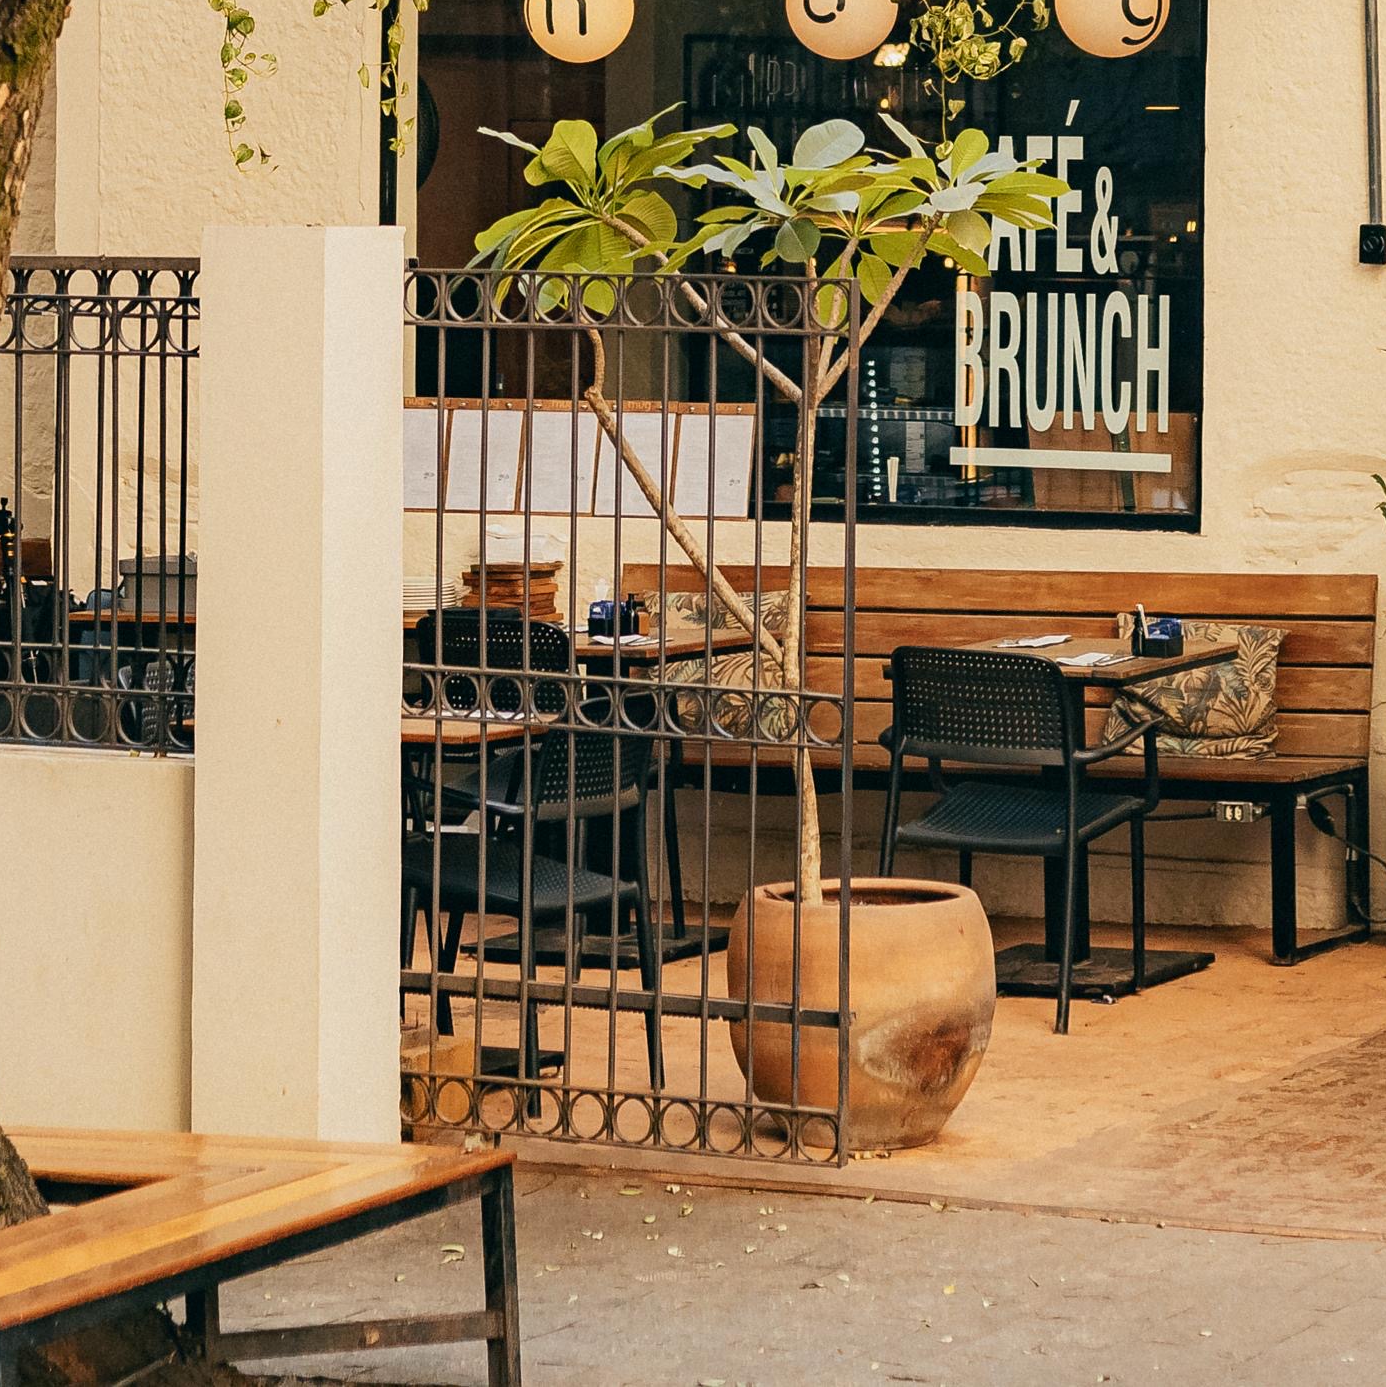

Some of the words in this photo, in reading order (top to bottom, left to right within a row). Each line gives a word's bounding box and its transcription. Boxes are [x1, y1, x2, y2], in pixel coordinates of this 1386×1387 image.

[988, 100, 1084, 273] AFÉ
[1090, 166, 1119, 275] &
[955, 290, 1170, 435] BRUNCH
